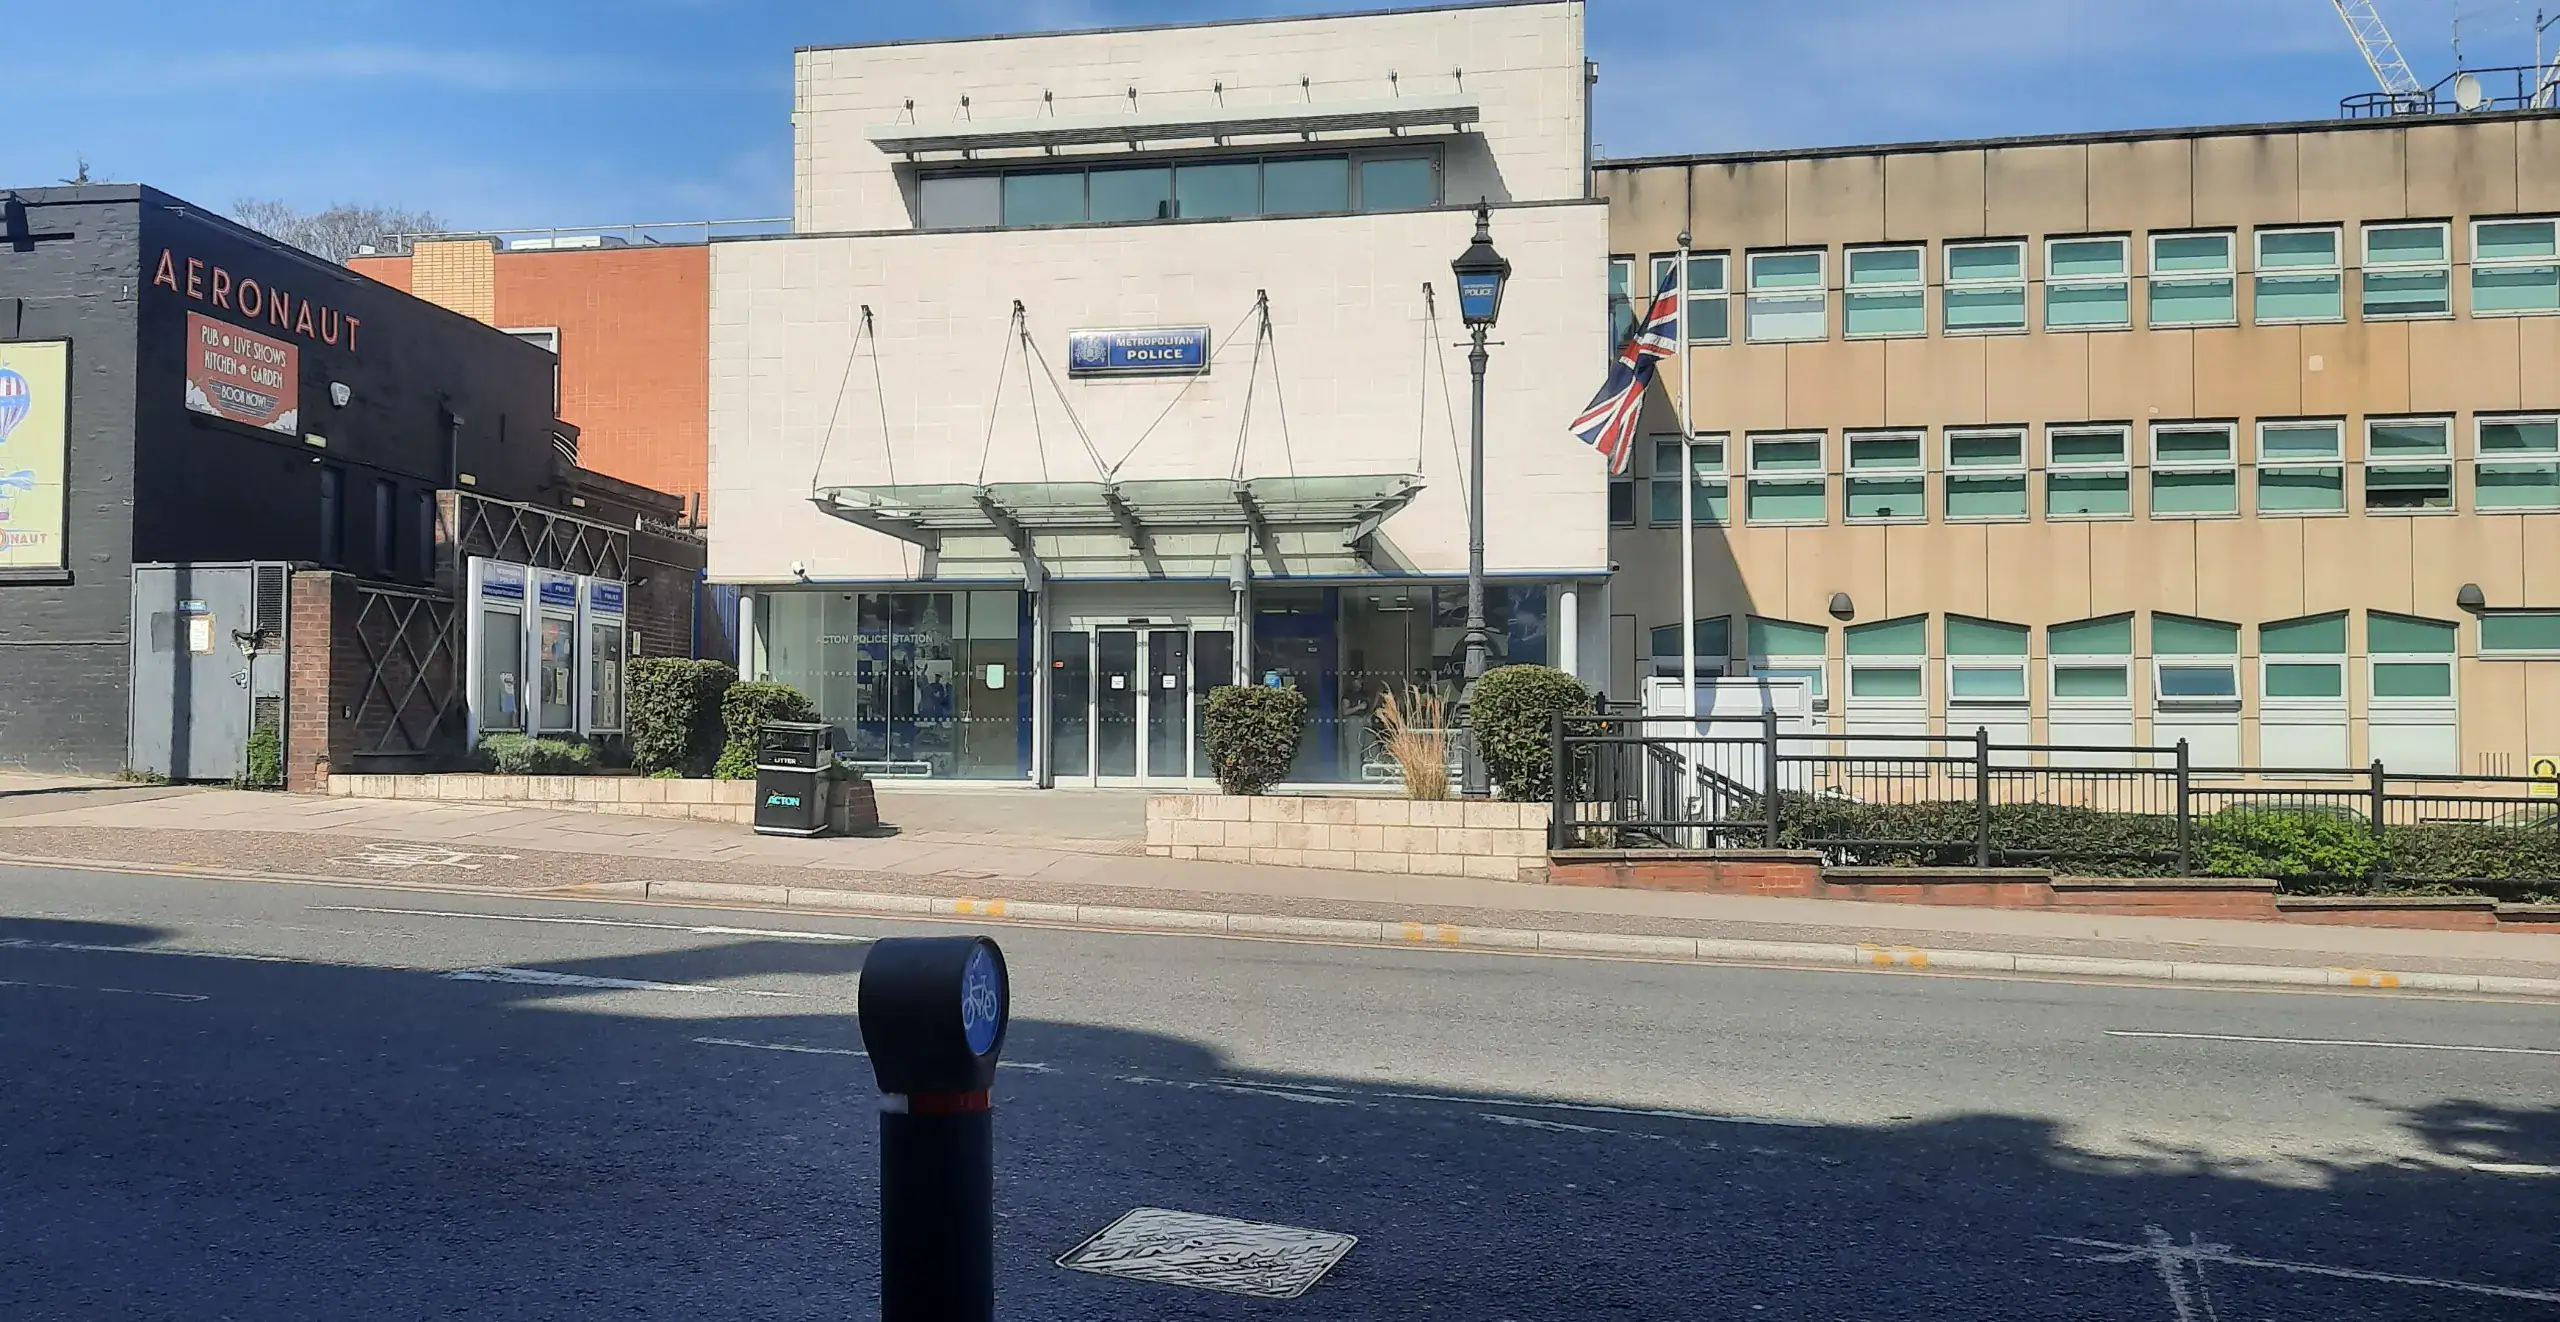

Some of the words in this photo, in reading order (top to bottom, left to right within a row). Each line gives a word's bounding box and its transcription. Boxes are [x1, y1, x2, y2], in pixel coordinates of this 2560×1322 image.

[1464, 288, 1493, 296] POLICE
[153, 248, 360, 352] AERONAUT
[201, 325, 219, 346] PUB
[233, 336, 251, 357] LIVE
[253, 343, 286, 367] SHOWS
[1116, 336, 1194, 347] METROPOLITAN
[1127, 349, 1184, 360] POLICE
[204, 350, 237, 376] KITCHEN
[250, 364, 283, 389] GARDEN
[221, 385, 245, 403] BOOK
[816, 635, 849, 644] ACTON
[852, 634, 888, 644] POLICE
[893, 634, 933, 644] STATION
[774, 757, 797, 765] LITTER
[766, 795, 800, 807] ACTON
